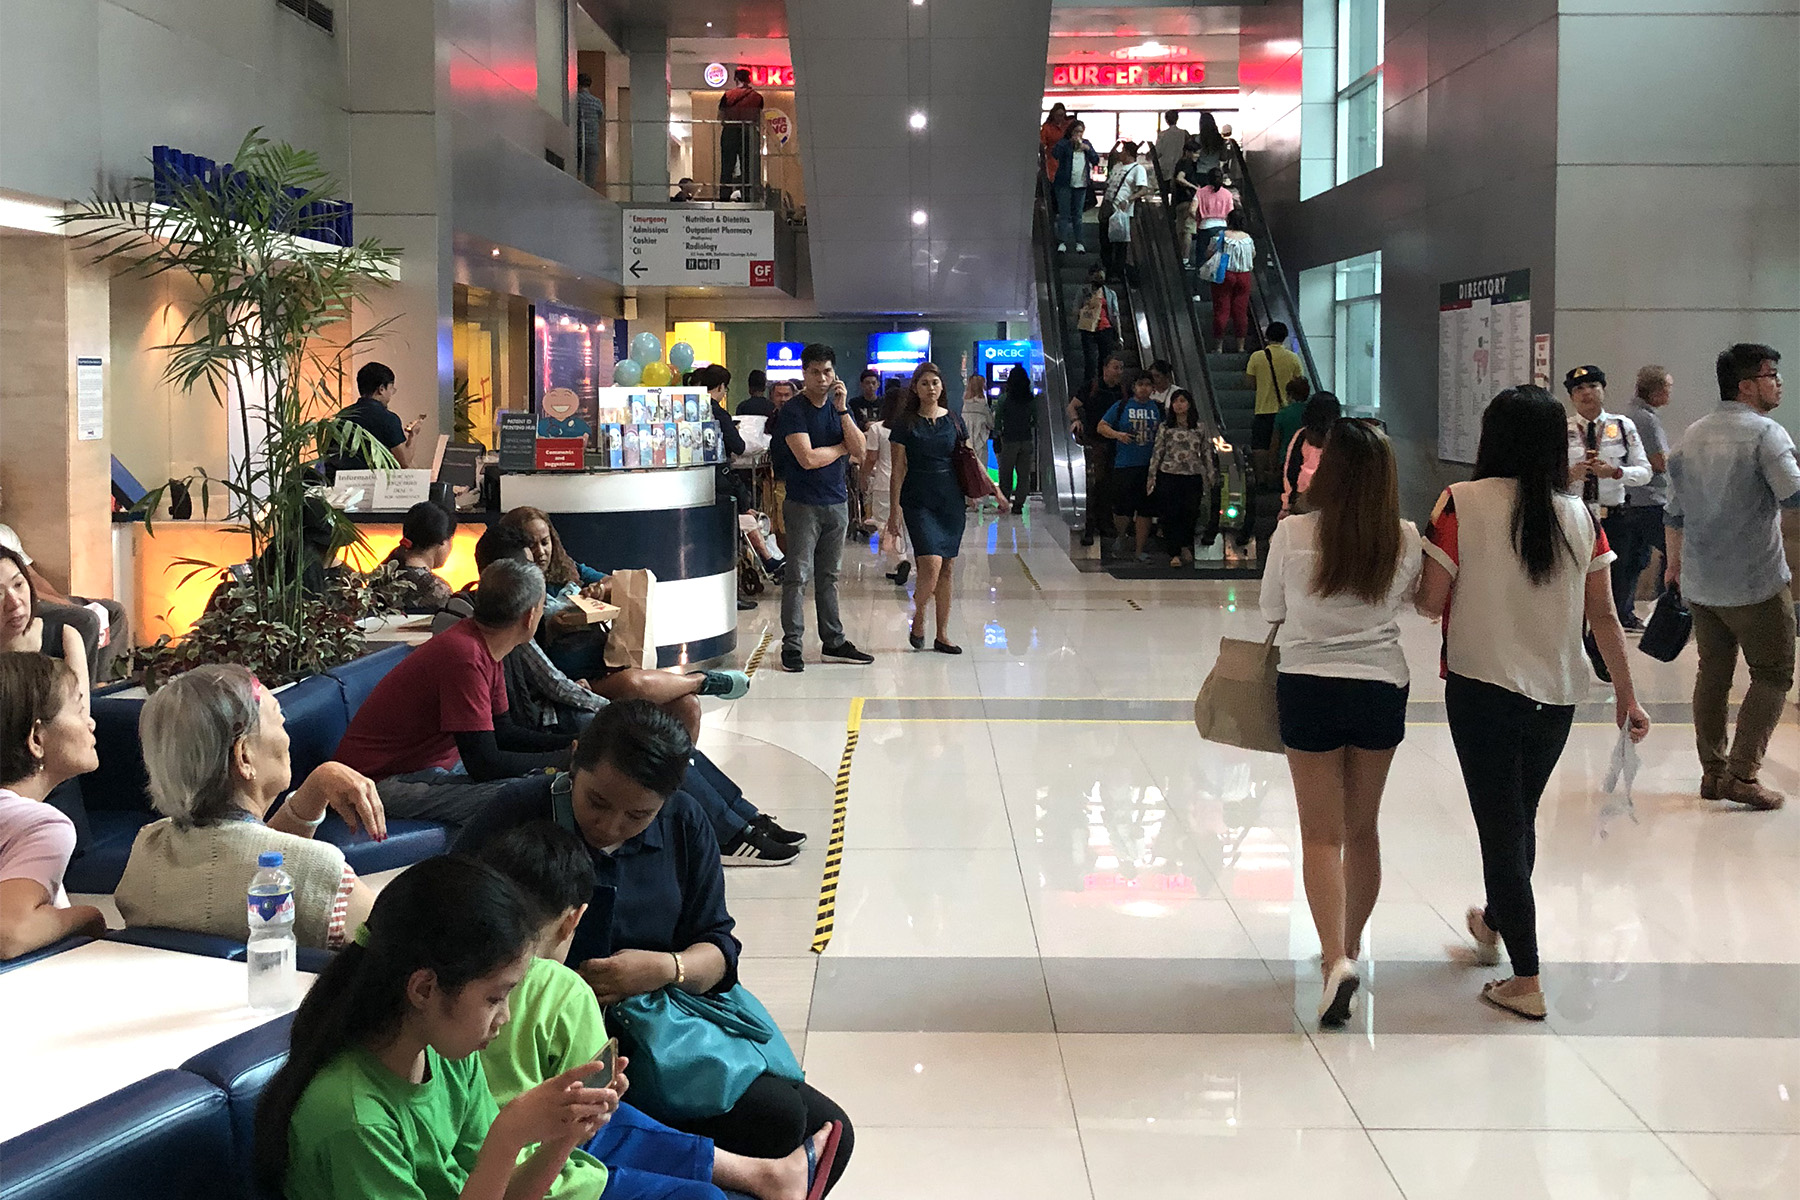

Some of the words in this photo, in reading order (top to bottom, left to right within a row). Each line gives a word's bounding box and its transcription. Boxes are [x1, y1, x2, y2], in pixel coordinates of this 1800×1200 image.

[1053, 64, 1144, 86] BURGER
[1147, 64, 1206, 86] KING
[633, 215, 667, 224] Emergency
[685, 215, 715, 223] Nutrition
[715, 215, 721, 223] &
[722, 215, 751, 224] Dietetics
[685, 225, 720, 235] Outpatient
[721, 226, 753, 235] Pharmacy
[633, 236, 657, 244] Cashier
[685, 242, 718, 252] Radiology
[754, 265, 771, 276] GF
[1459, 277, 1506, 299] DIRECTORY
[997, 348, 1025, 358] RCBC
[1128, 408, 1157, 420] BALL
